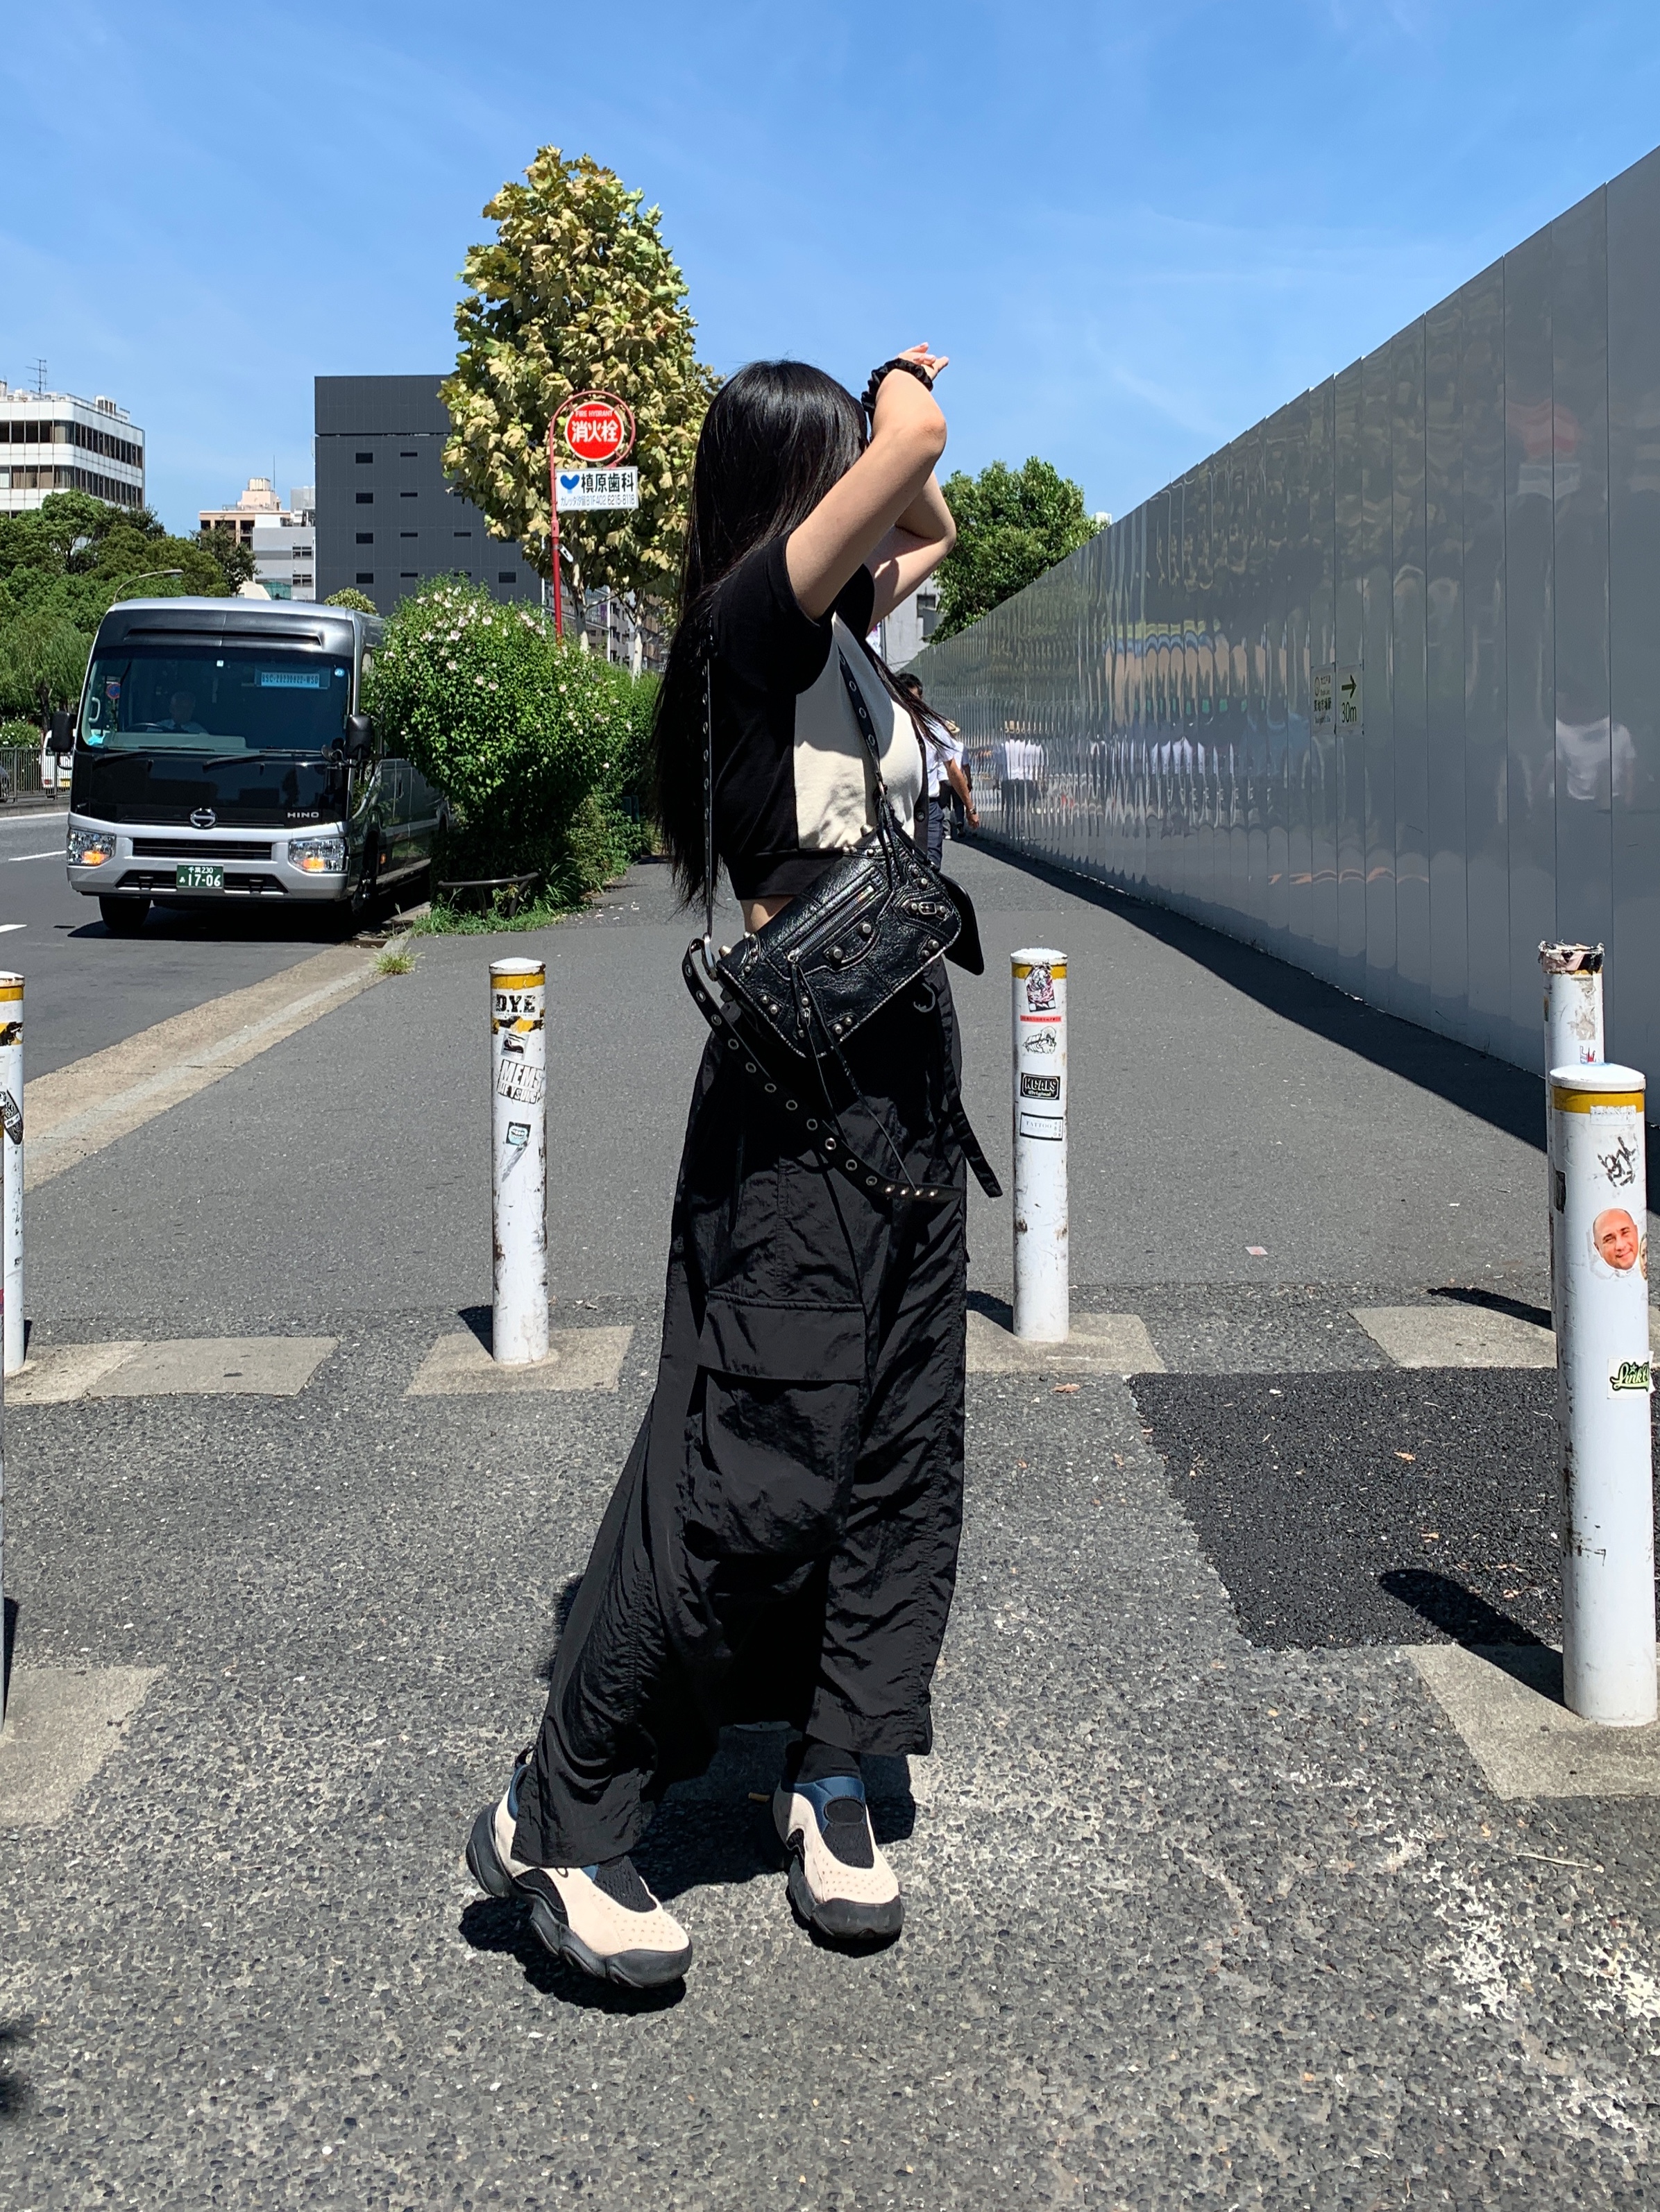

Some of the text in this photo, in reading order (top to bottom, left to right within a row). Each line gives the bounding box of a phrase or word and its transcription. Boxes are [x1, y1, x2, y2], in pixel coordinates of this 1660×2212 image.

[571, 420, 618, 443] 消火栓
[1341, 701, 1357, 723] 30m
[188, 874, 221, 887] 17-06
